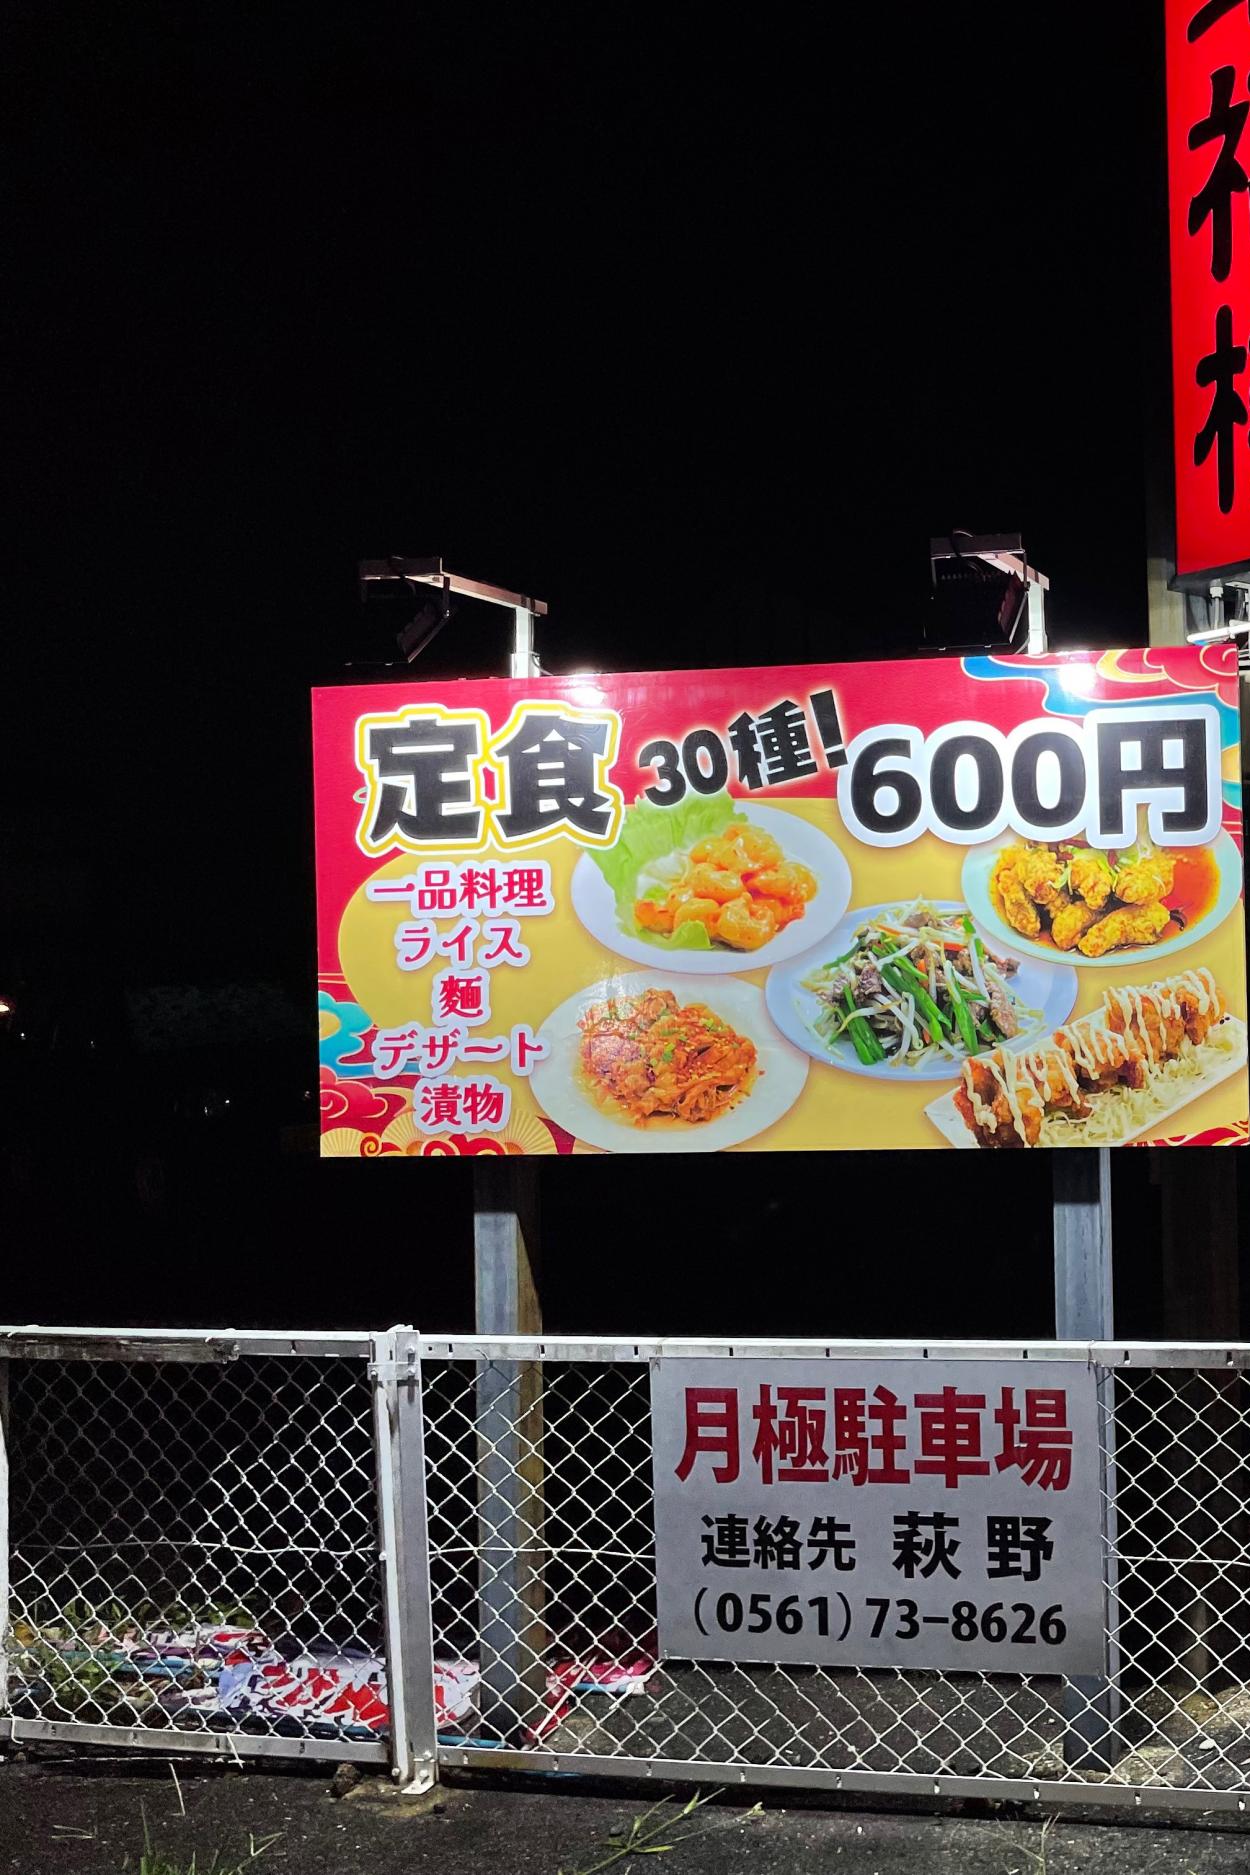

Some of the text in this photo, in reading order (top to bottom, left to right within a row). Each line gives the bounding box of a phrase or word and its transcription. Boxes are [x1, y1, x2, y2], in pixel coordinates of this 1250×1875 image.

[367, 688, 1209, 844] 定食 30種! 600円
[373, 868, 548, 911] 一品料理
[400, 926, 524, 965] ライス
[378, 1029, 544, 1069] デザート
[419, 1082, 506, 1125] 漬物
[674, 1383, 1074, 1492] 月極駐車場
[700, 1513, 857, 1572] 連絡先
[693, 1587, 1067, 1646] (0561)73-8626
